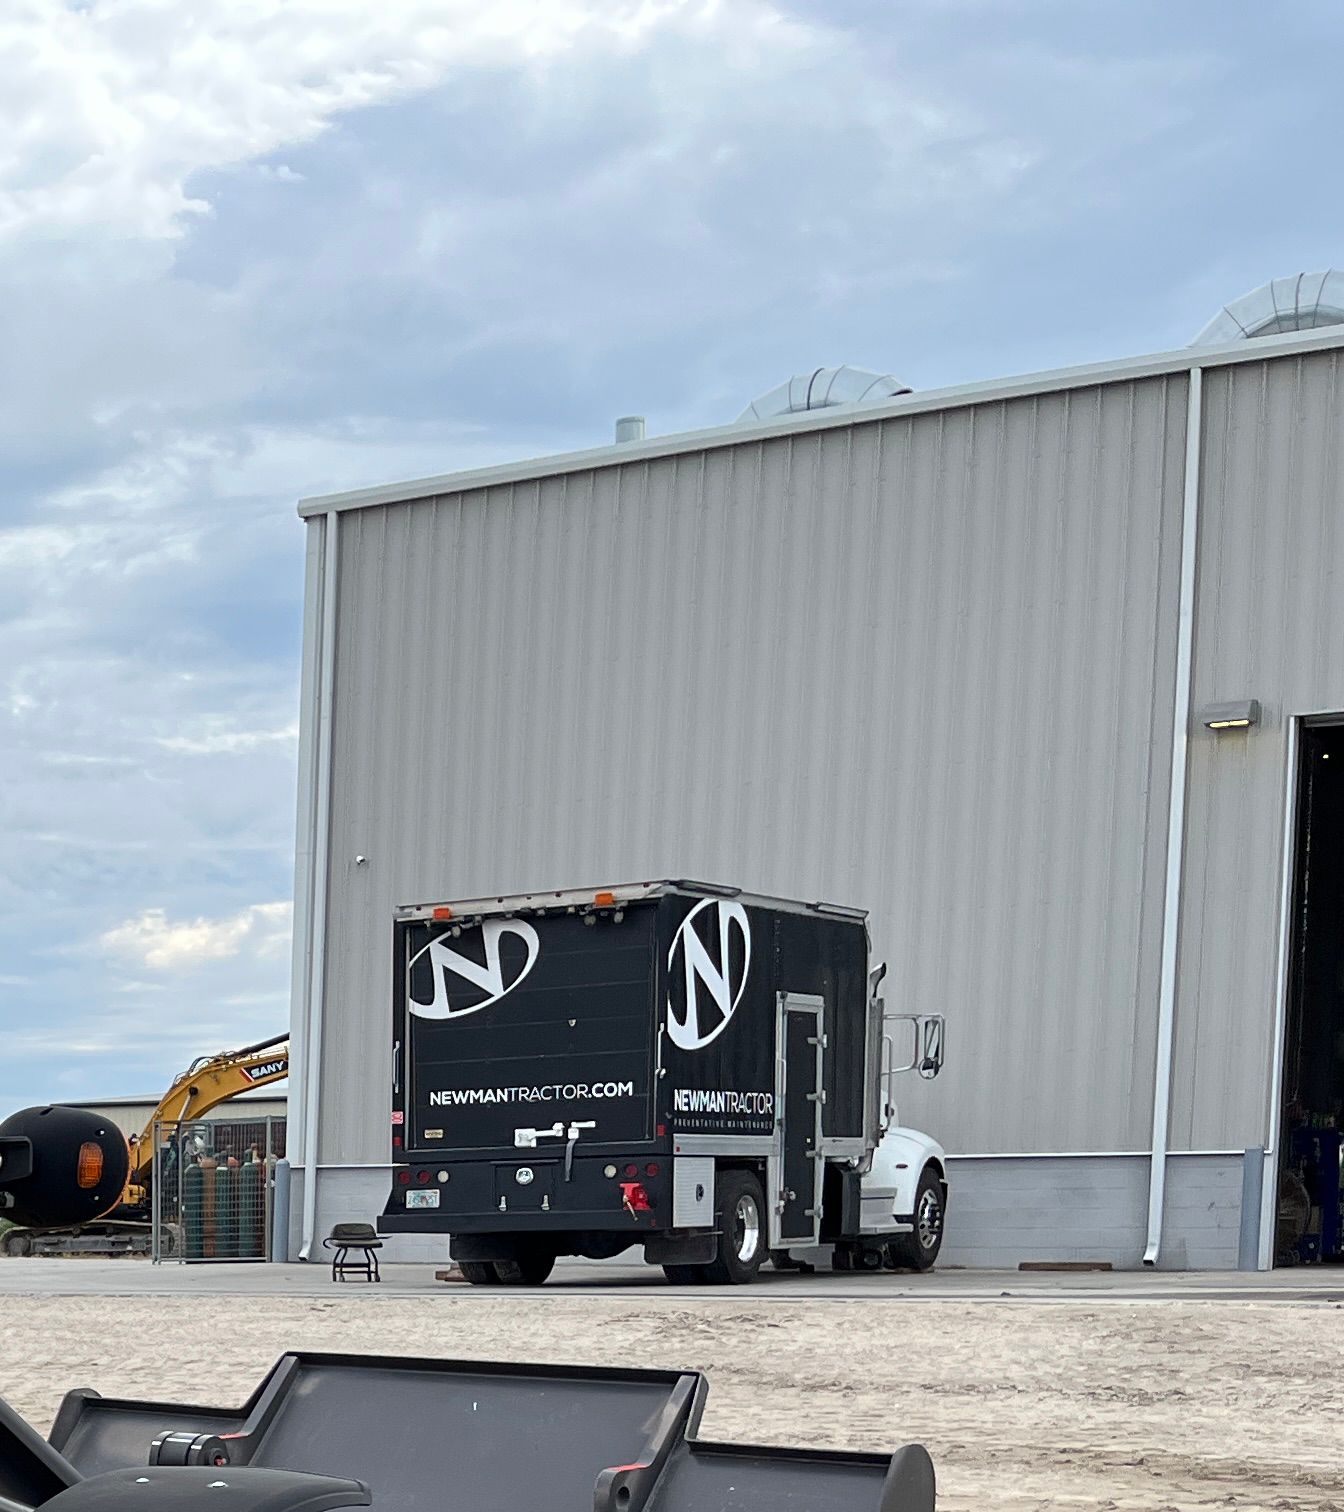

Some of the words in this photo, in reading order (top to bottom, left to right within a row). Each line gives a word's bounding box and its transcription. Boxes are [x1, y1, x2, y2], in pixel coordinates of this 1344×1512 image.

[251, 1060, 284, 1078] SANY
[430, 1081, 633, 1106] NEWMANTRACTOR.COM
[674, 1088, 772, 1114] NEWMANTRACTOR
